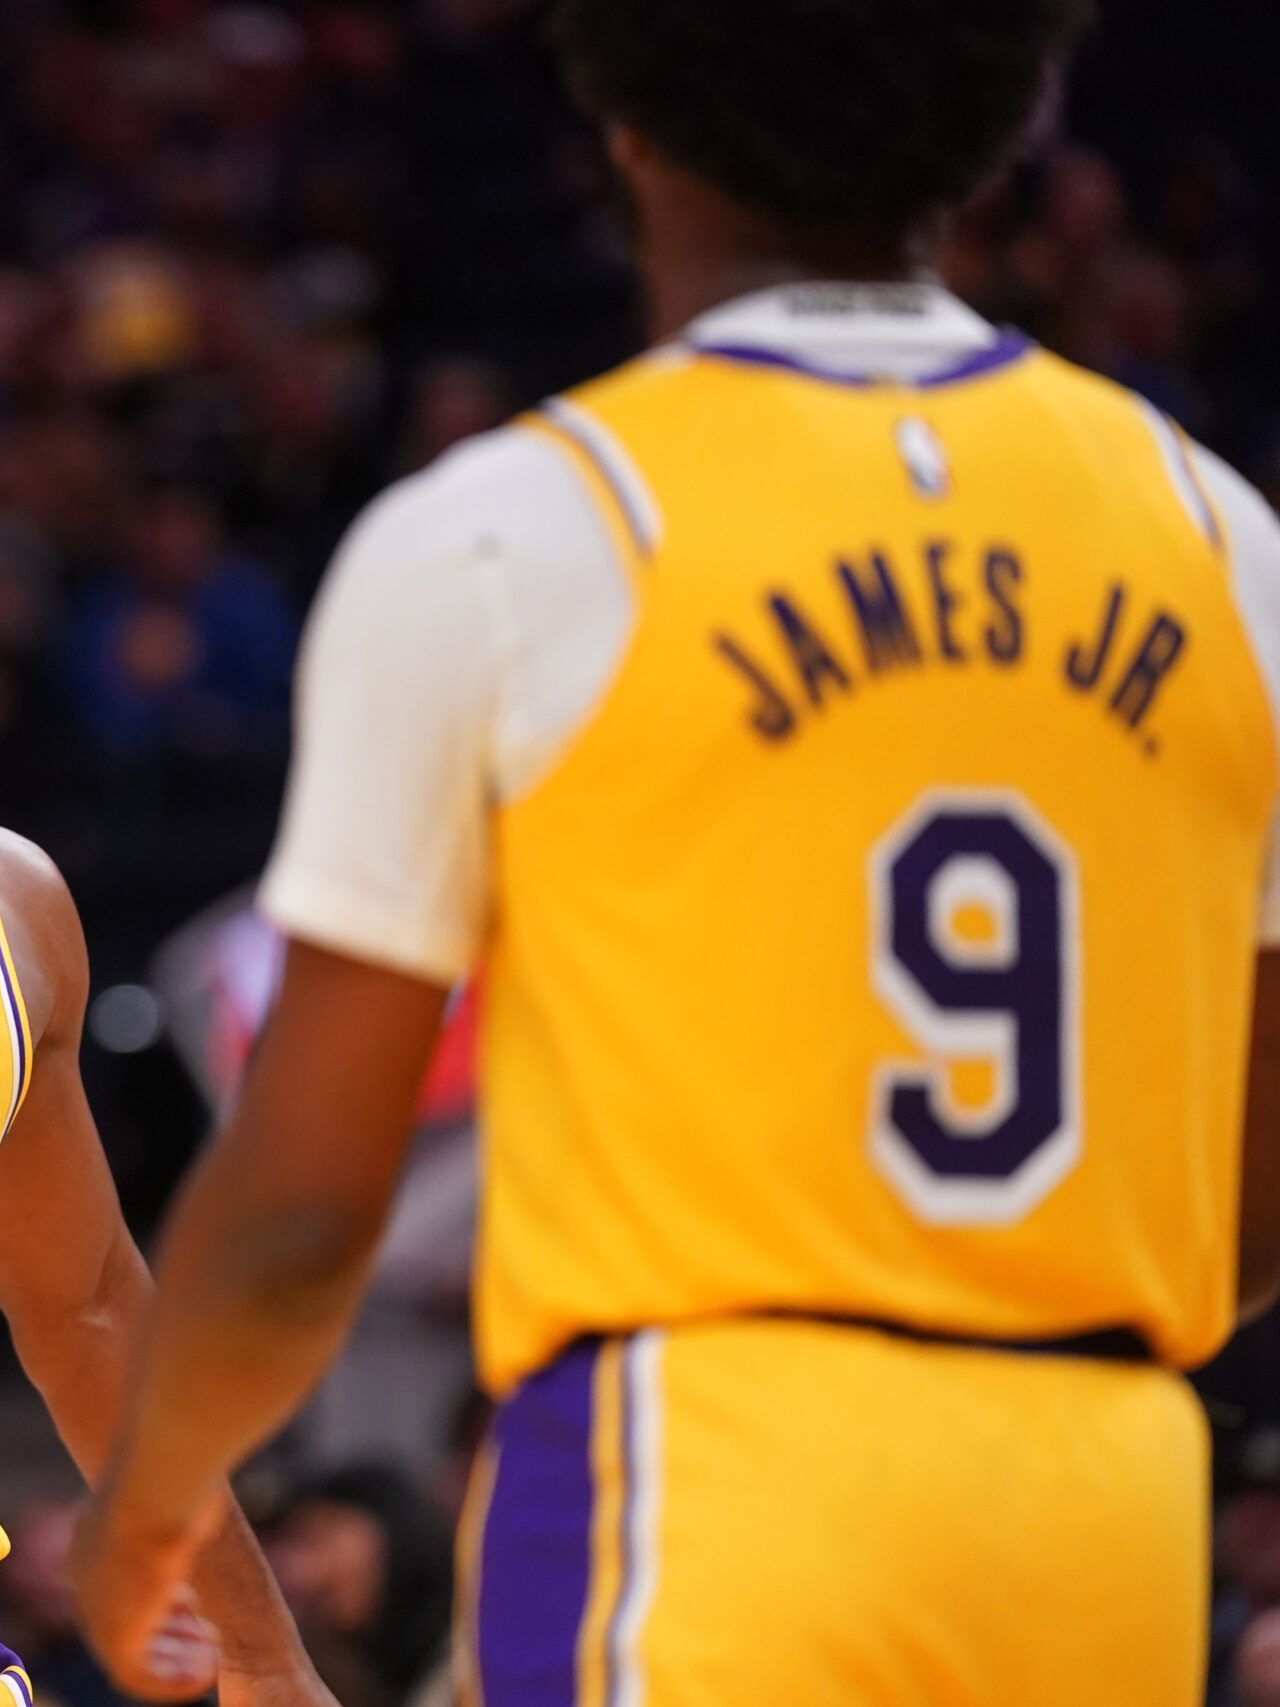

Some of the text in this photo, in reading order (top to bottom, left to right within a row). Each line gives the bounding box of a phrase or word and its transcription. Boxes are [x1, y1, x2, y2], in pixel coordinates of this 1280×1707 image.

[713, 540, 1186, 760] JAMES JR.
[868, 787, 1080, 1225] 9
